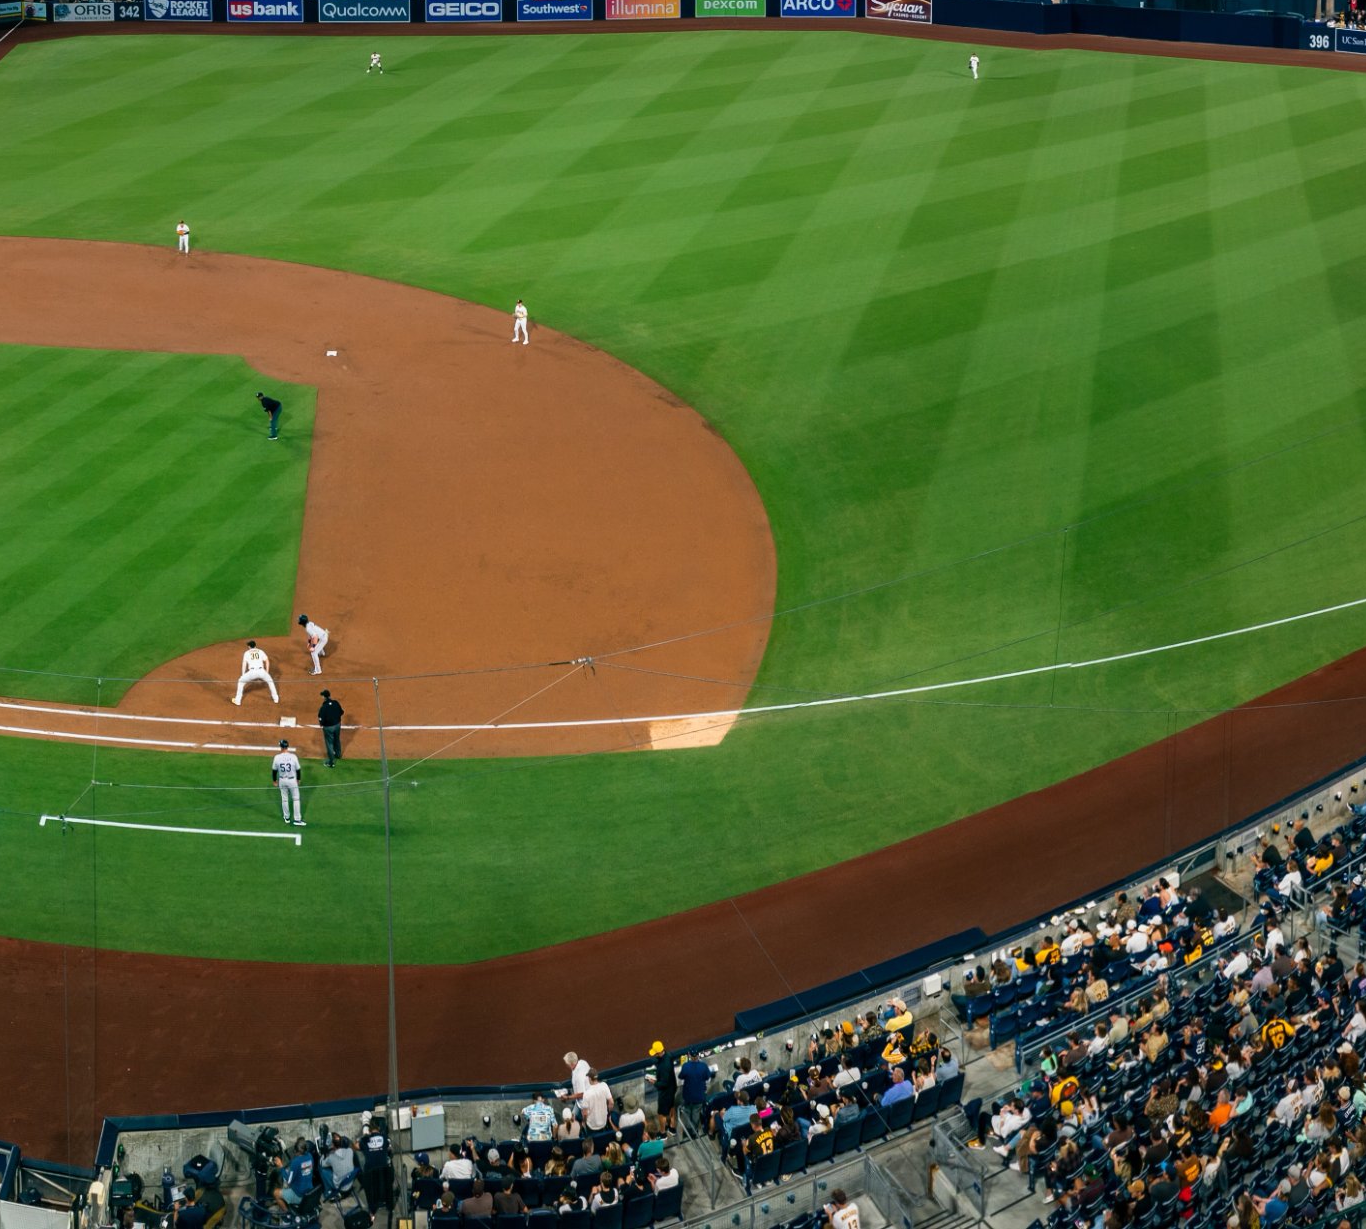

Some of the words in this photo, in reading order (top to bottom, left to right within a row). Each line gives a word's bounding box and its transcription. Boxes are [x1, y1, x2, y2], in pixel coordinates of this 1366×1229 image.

[74, 5, 112, 16] ORIS
[170, 1, 208, 9] ROCKET
[322, 2, 407, 18] Qualcomm
[428, 2, 499, 16] GEICO
[522, 3, 580, 15] Southwest
[610, 0, 674, 16] illumina
[119, 6, 140, 18] 342
[170, 8, 209, 17] LEAGUE
[1309, 34, 1329, 49] 396
[1342, 36, 1353, 44] UC
[1353, 37, 1365, 45] San
[250, 652, 259, 660] 30
[280, 763, 292, 772] 53
